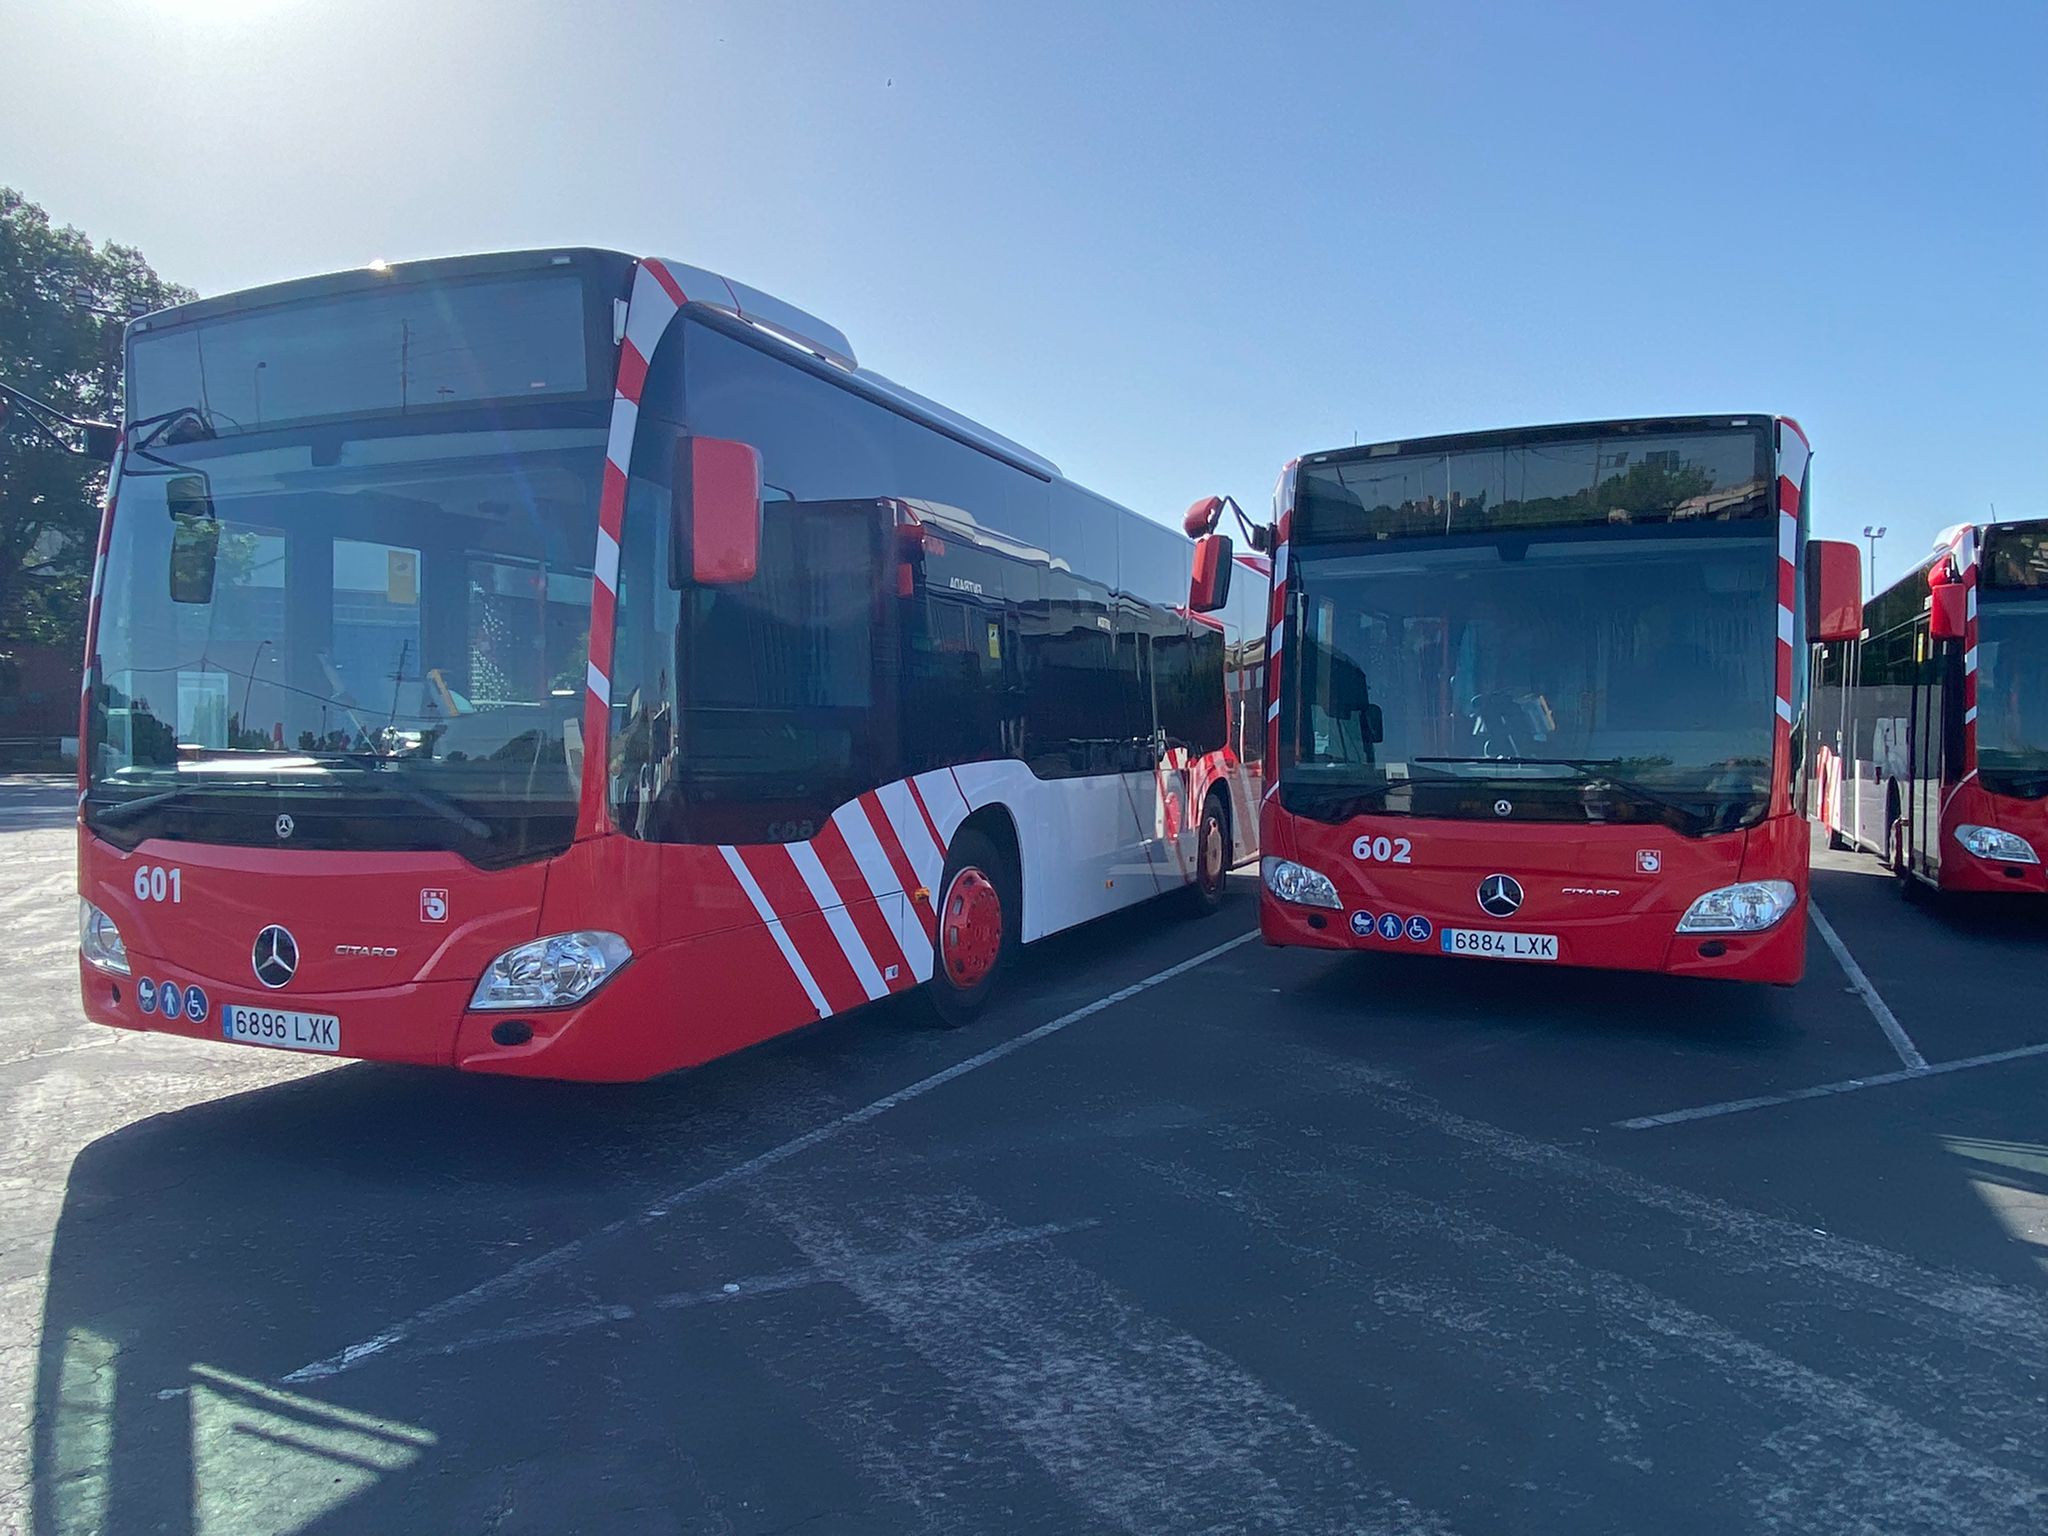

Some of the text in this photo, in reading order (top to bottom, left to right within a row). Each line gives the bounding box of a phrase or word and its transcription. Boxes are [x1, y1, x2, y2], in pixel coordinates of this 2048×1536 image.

[1352, 835, 1412, 863] 602
[134, 865, 181, 903] 601
[334, 944, 398, 958] CITARO
[1456, 932, 1553, 956] 6884 LXK
[236, 1010, 334, 1045] 6896 LXK
